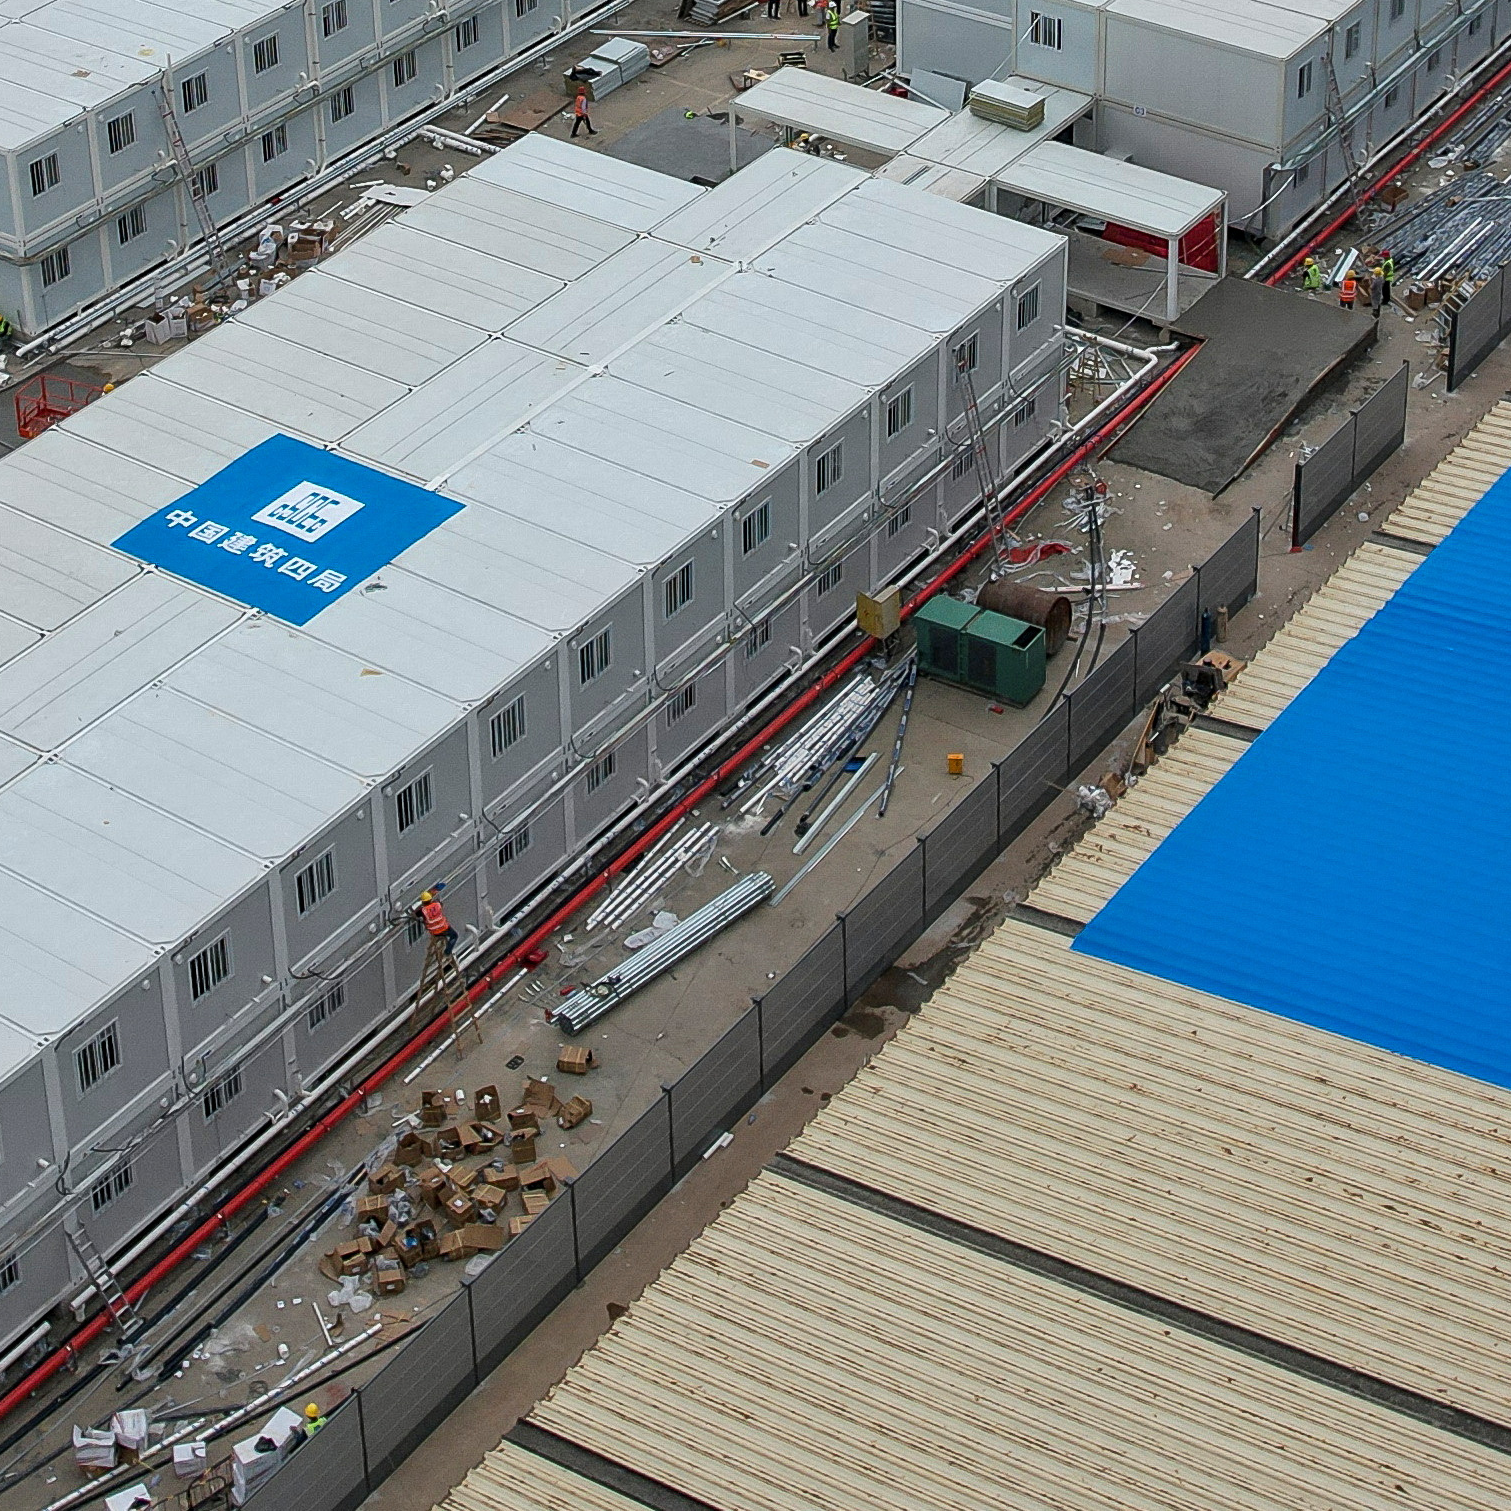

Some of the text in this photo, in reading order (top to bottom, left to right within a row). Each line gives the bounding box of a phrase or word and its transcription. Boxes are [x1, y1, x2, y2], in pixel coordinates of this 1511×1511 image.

[164, 509, 348, 593] 中国建筑四局
